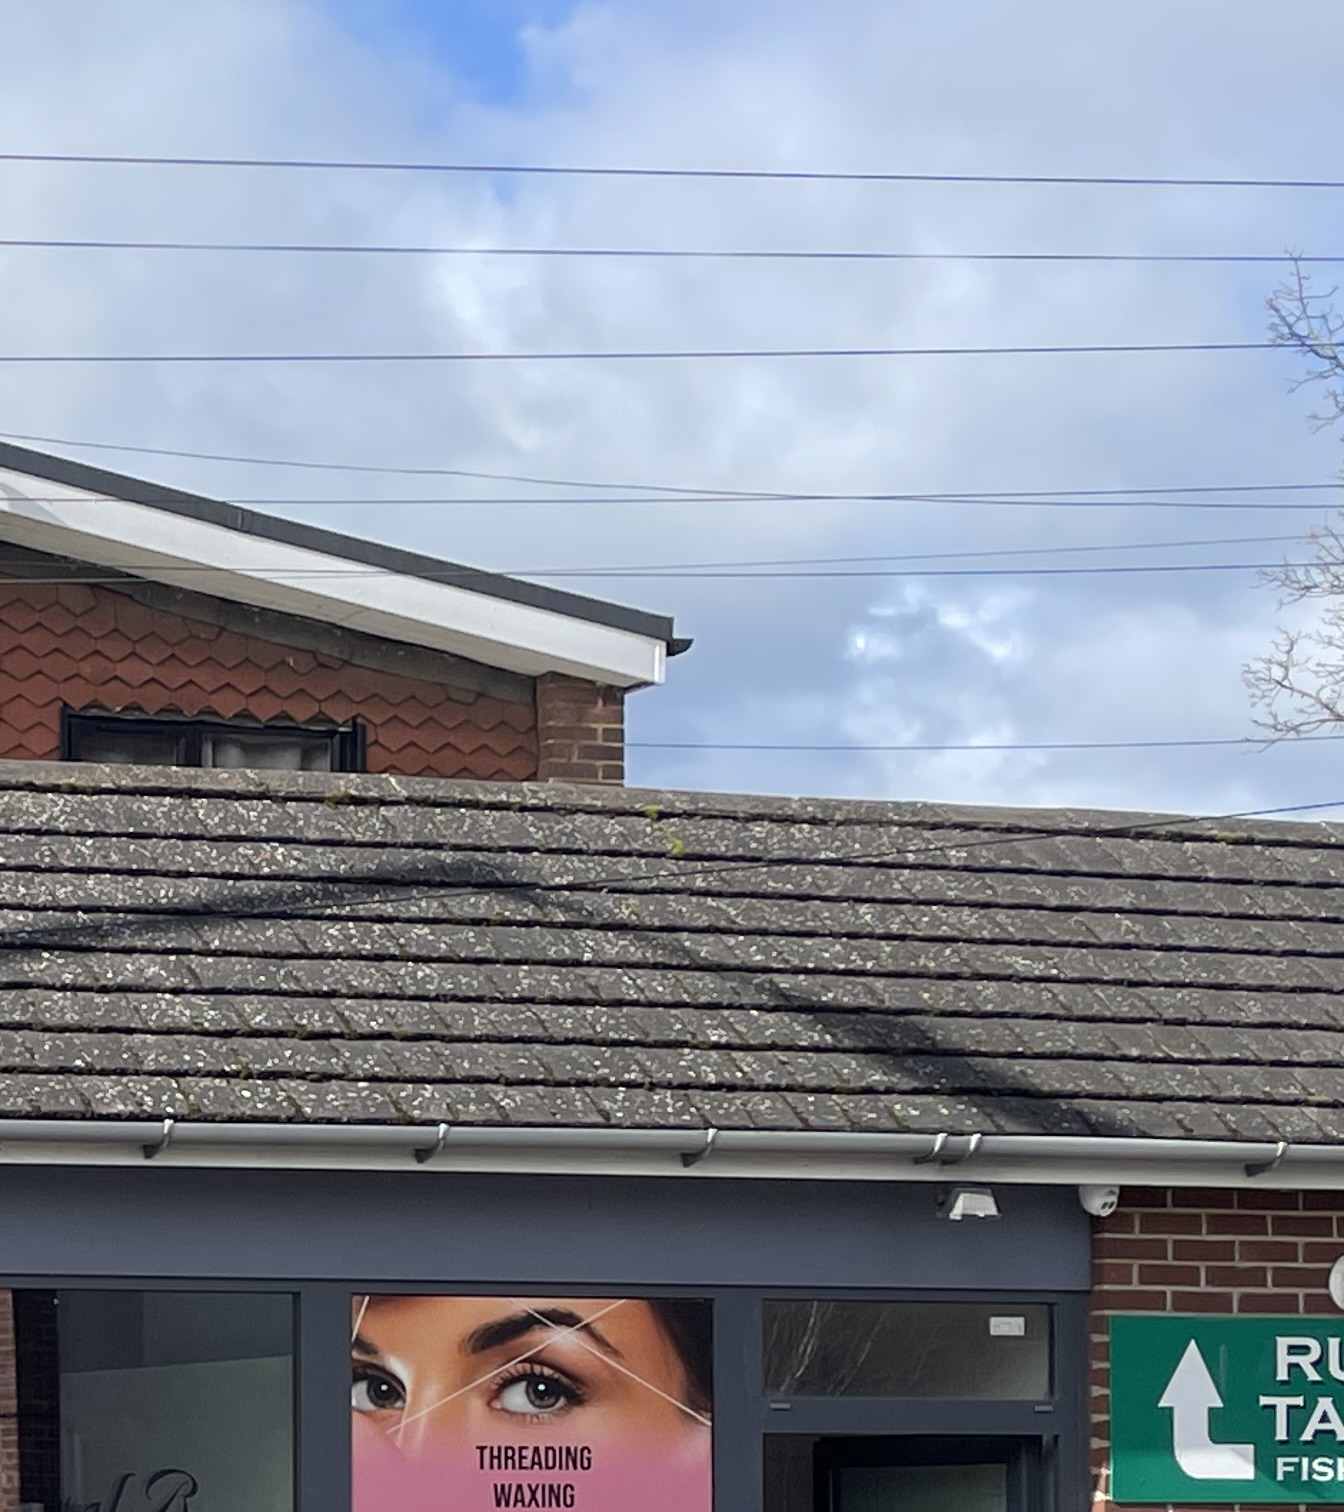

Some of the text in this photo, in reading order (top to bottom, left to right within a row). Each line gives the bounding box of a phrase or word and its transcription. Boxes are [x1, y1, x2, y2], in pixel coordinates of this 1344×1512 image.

[475, 1445, 593, 1471] THREADING
[1275, 1456, 1344, 1482] FIS
[492, 1482, 576, 1509] WAXING
